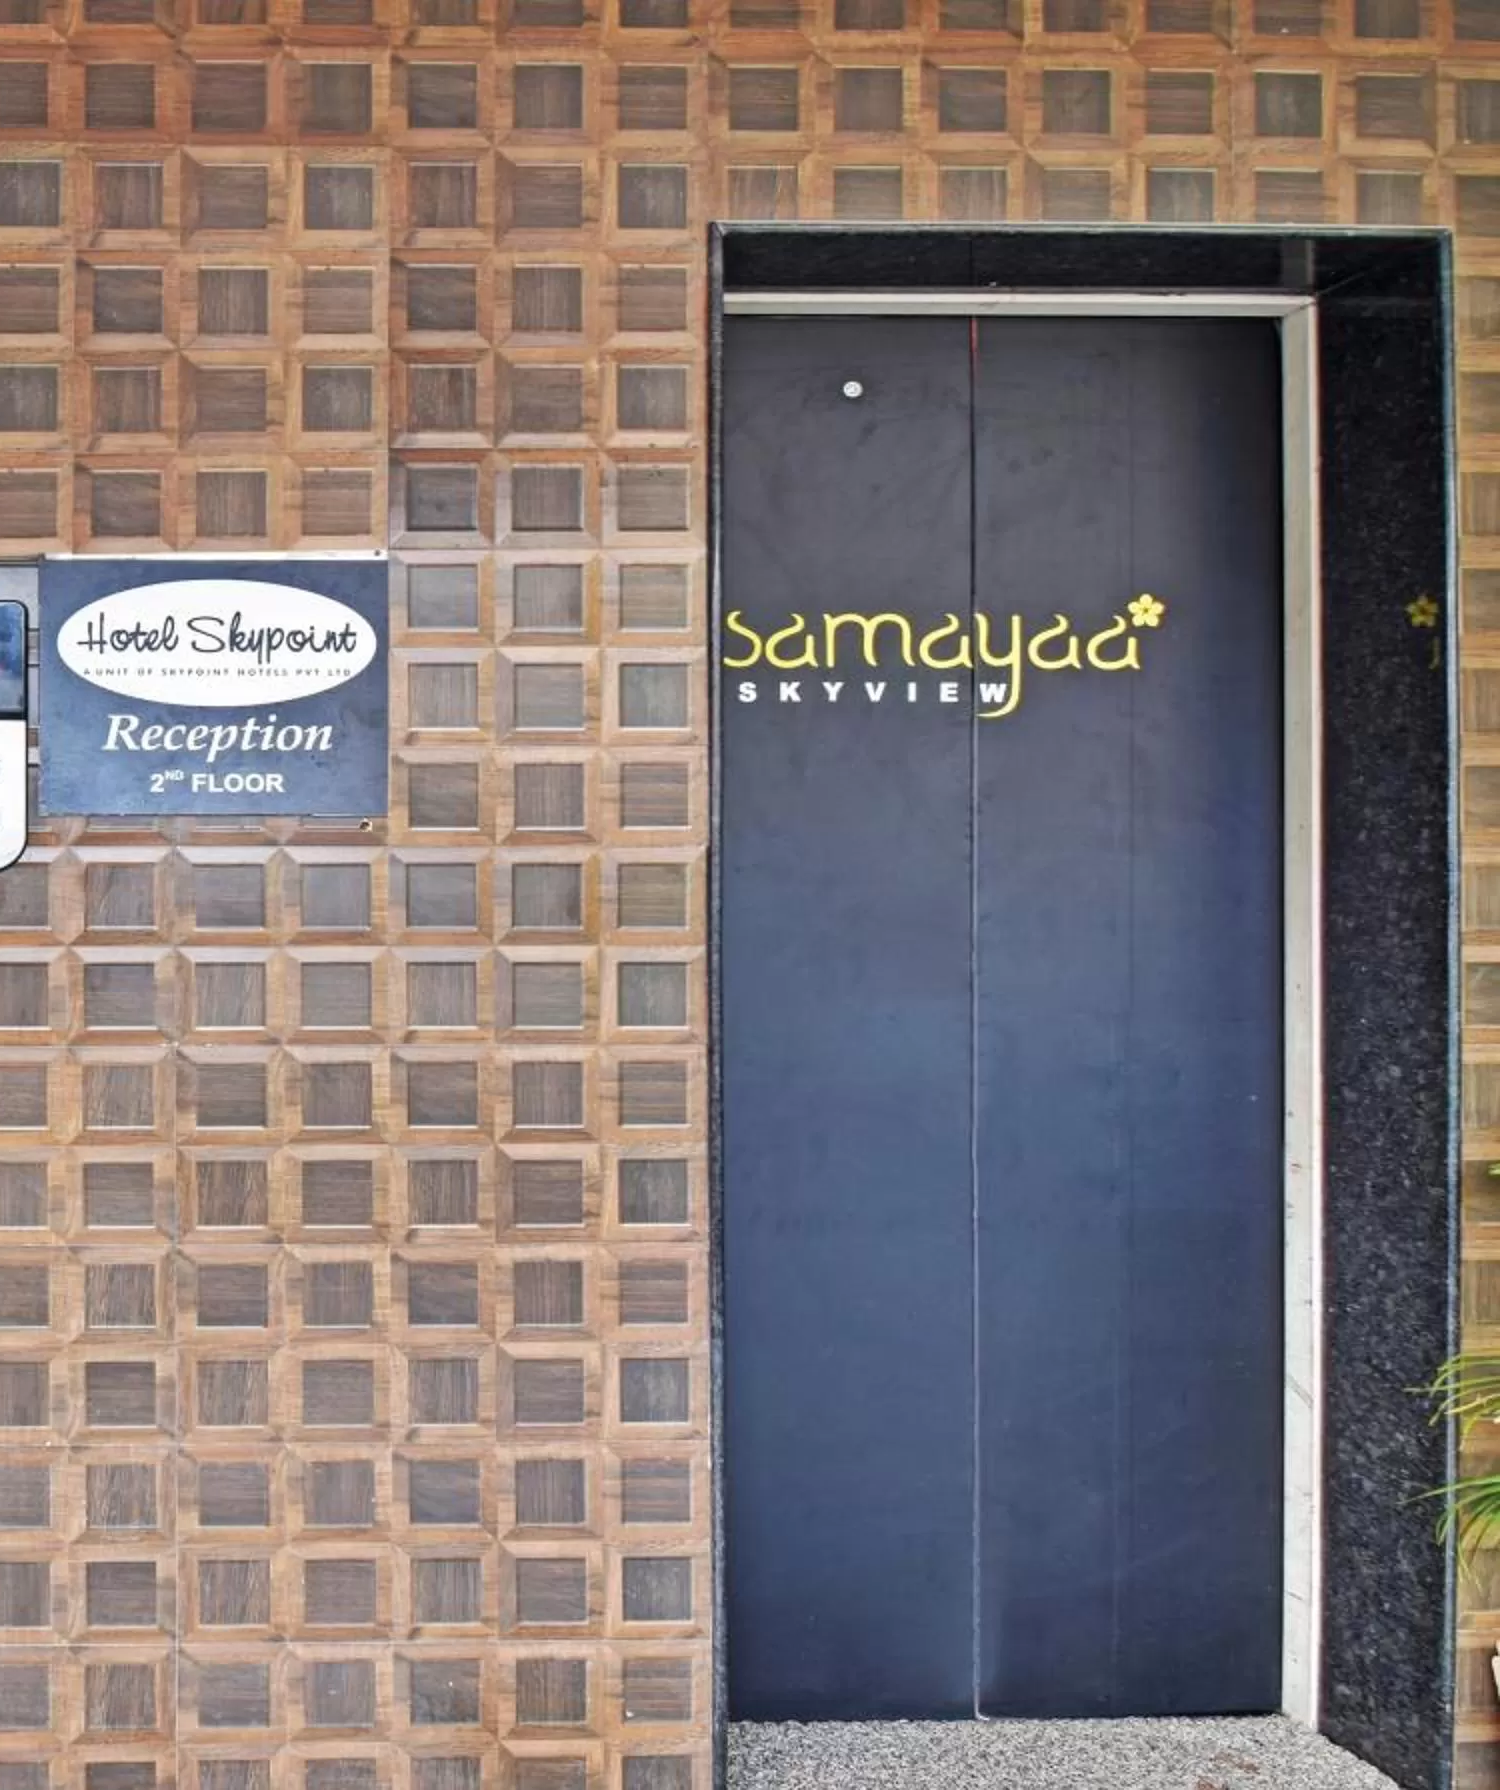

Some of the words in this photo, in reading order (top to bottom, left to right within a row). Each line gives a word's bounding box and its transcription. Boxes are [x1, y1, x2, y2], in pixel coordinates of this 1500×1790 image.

[76, 611, 180, 654] Hotel
[187, 611, 358, 664] Skypoint
[95, 667, 128, 676] UNIT
[137, 667, 153, 676] OF
[161, 667, 229, 676] SKYPOINT
[237, 667, 289, 676] HOTELS
[295, 667, 320, 676] PVT
[327, 667, 351, 676] LTD
[738, 681, 1007, 703] SKYVIEW
[101, 713, 334, 763] Reception
[149, 769, 185, 793] 2ND
[191, 773, 286, 793] FLOOR
